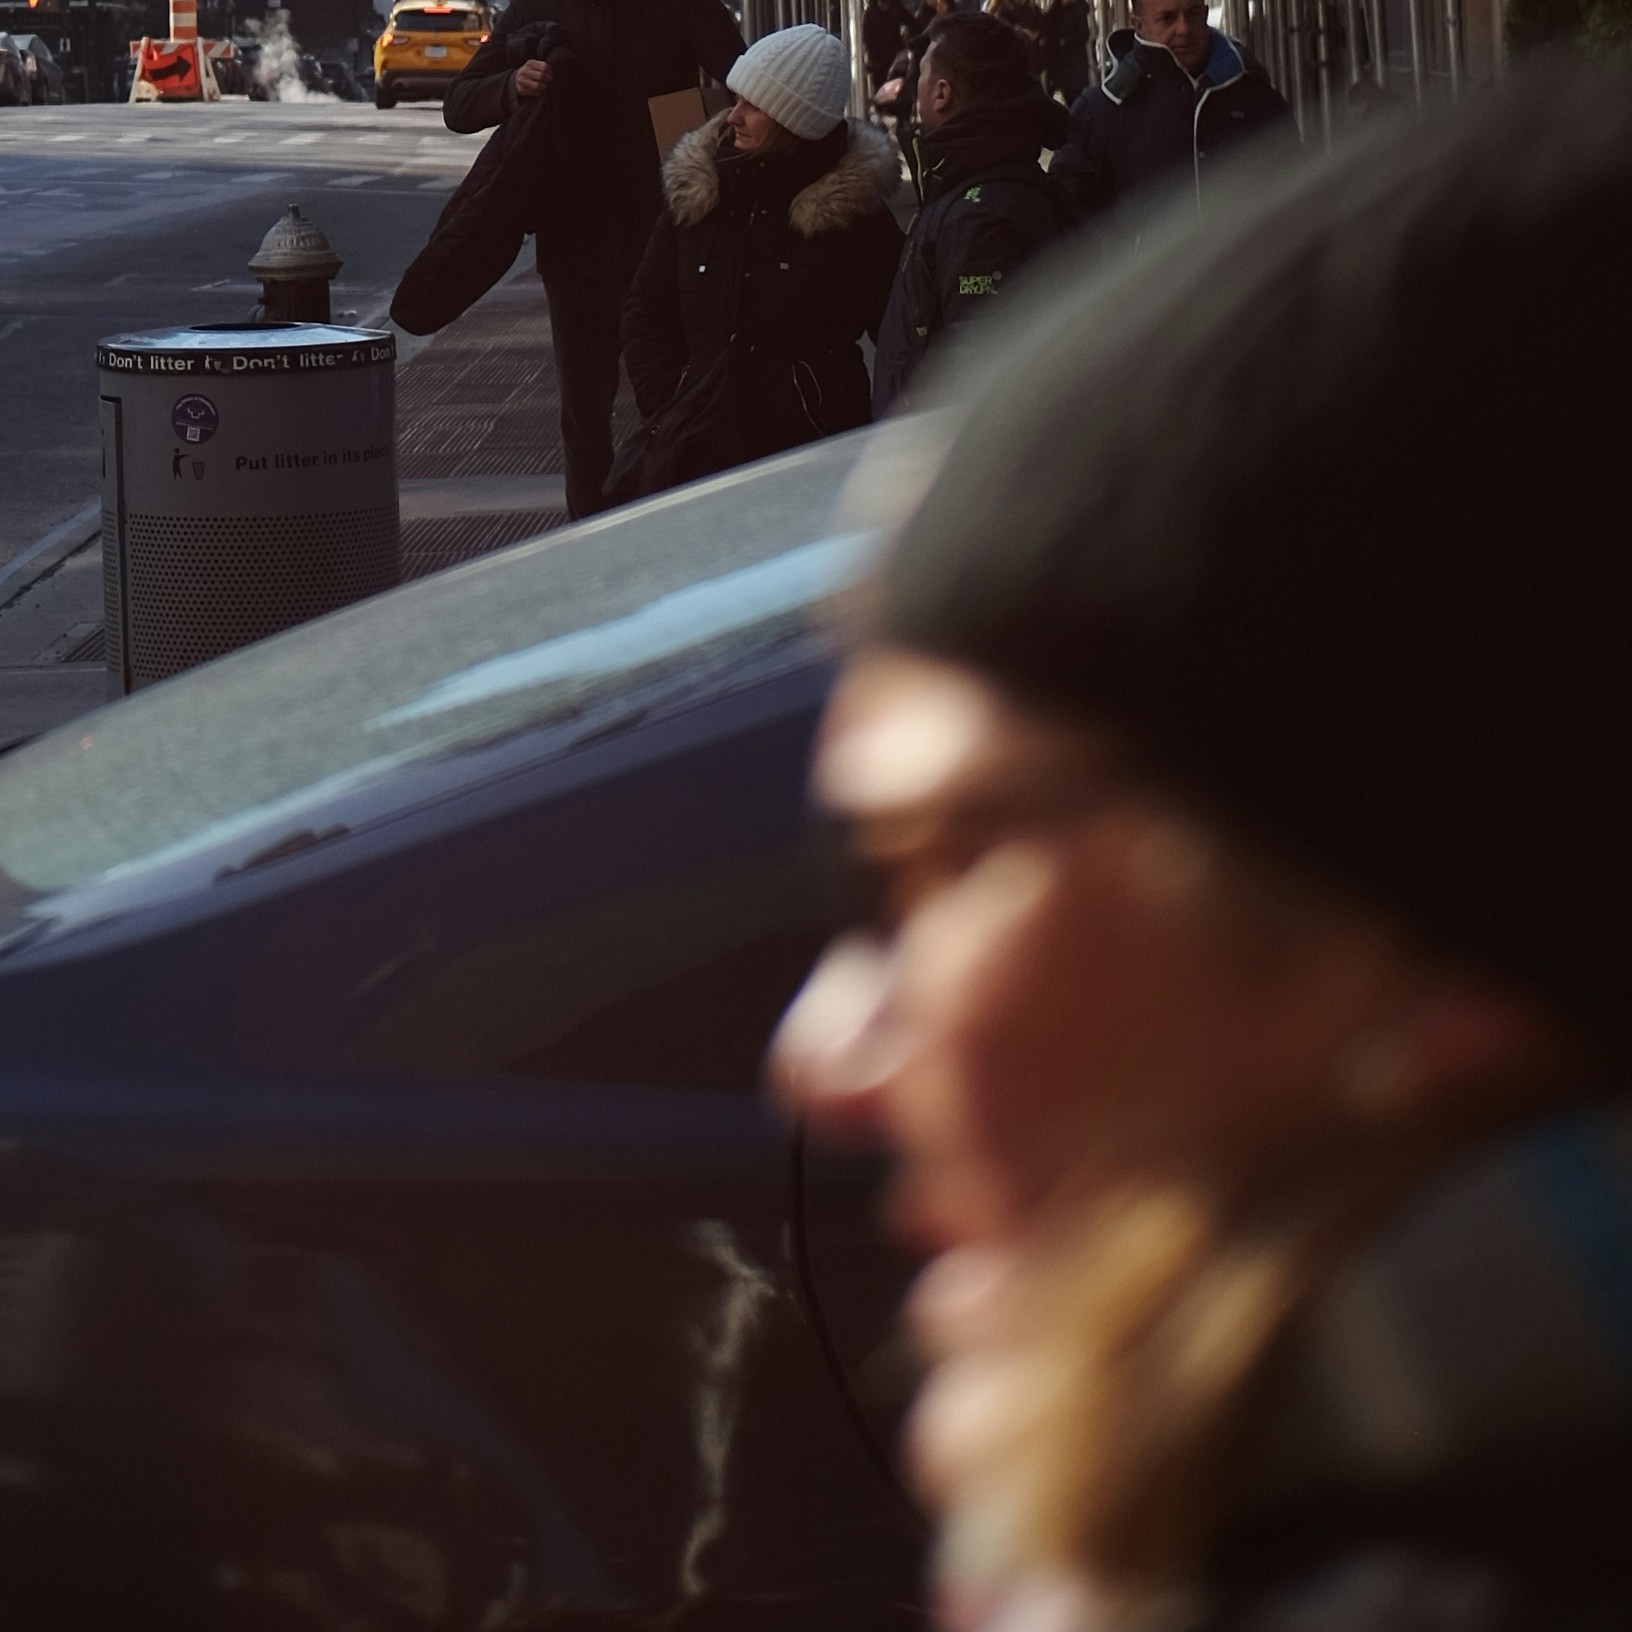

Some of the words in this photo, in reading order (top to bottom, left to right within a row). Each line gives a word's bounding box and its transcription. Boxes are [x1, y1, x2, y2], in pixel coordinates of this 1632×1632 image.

[958, 275, 993, 285] SUPER
[108, 351, 143, 370] Don't
[150, 354, 195, 371] litter
[232, 354, 290, 370] Don't
[235, 455, 268, 471] Put
[275, 452, 319, 469] litter
[323, 451, 338, 466] in
[341, 448, 360, 464] its
